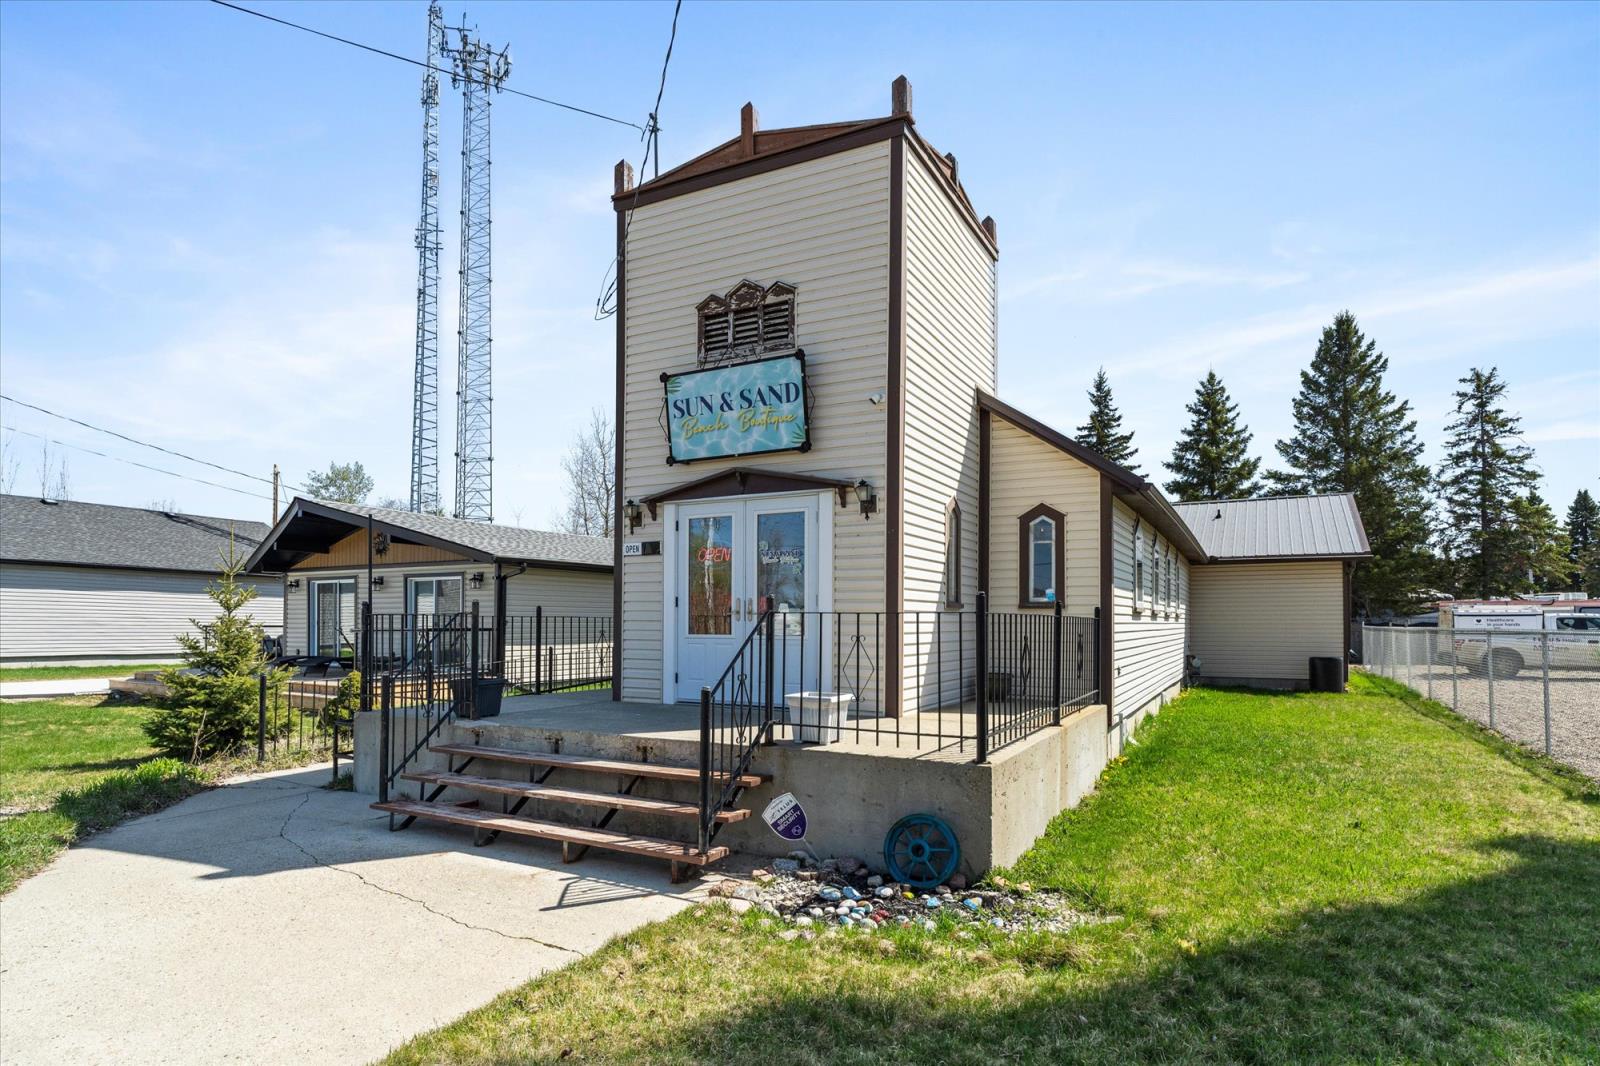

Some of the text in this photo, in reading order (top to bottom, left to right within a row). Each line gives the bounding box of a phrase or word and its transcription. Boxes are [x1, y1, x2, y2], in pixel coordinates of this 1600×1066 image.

[673, 382, 800, 419] SUN & SAND
[681, 406, 798, 440] Beach Boutique
[625, 544, 640, 554] OPEN
[697, 546, 732, 562] OPEN
[777, 809, 796, 824] SMART
[777, 811, 801, 831] SECURITY
